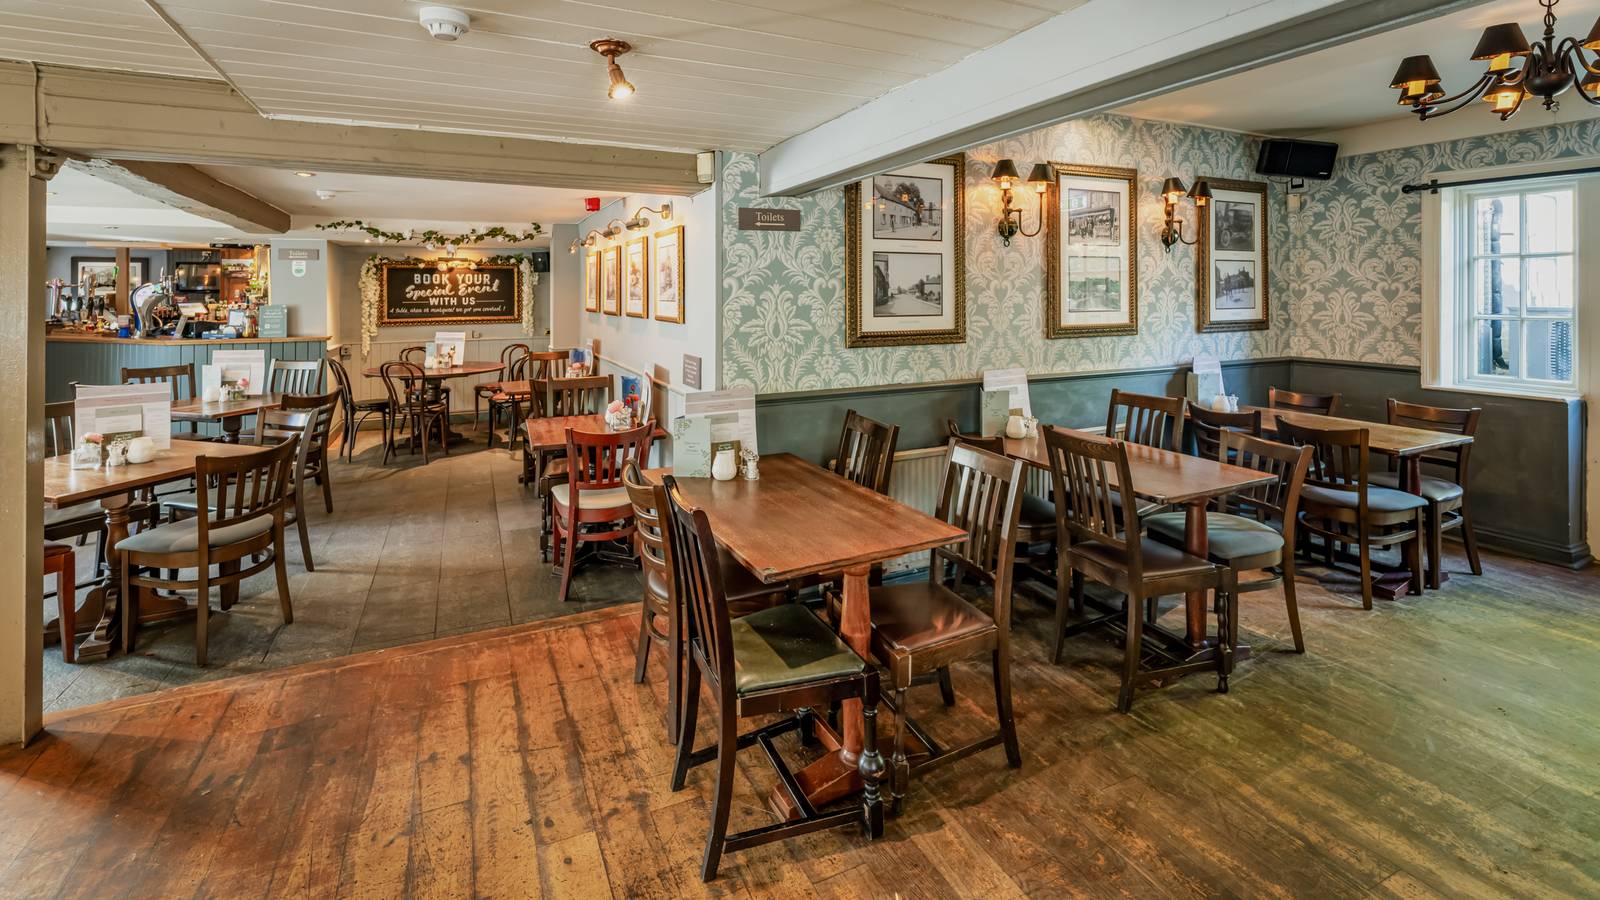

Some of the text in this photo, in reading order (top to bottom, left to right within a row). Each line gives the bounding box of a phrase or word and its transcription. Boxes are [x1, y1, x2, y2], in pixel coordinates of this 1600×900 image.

[755, 211, 785, 222] Toilets
[413, 273, 491, 285] BOOK YOUR
[405, 279, 500, 301] Special Event
[429, 297, 476, 306] WITH US
